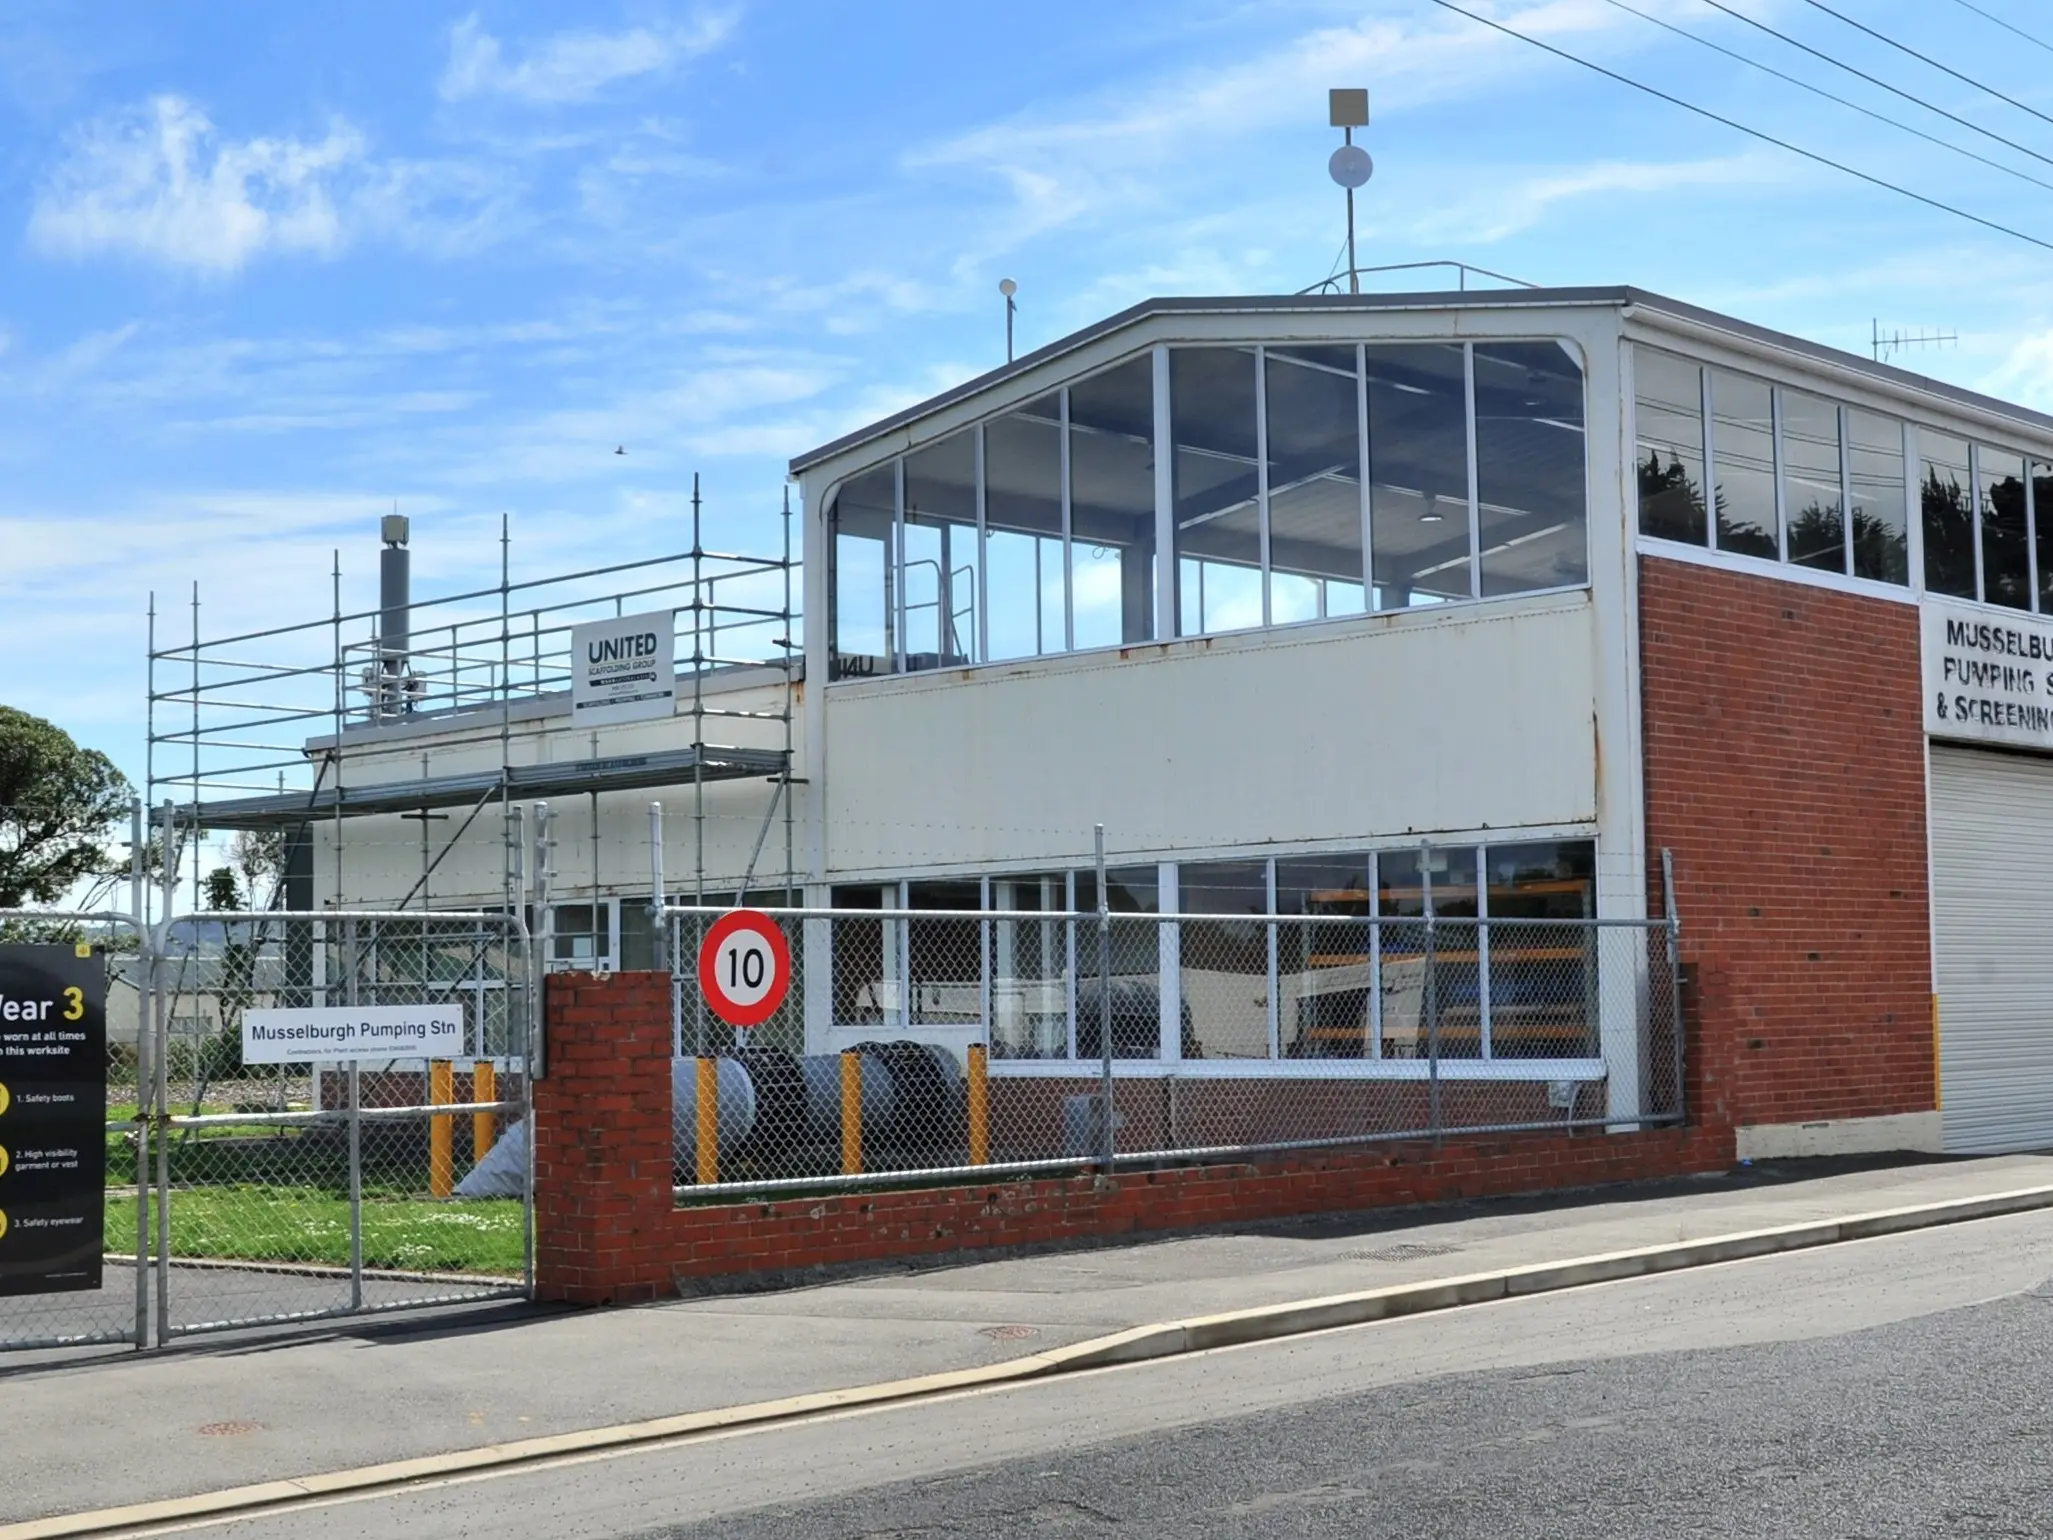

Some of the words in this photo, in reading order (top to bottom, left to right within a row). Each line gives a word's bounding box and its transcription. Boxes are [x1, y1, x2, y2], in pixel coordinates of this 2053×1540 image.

[589, 633, 657, 663] UNITED
[632, 659, 656, 670] GROUP
[1944, 656, 2034, 695] PUMPING
[1937, 692, 1948, 719] &
[728, 948, 764, 988] 10
[0, 994, 54, 1021] ear
[63, 986, 84, 1021] 3
[3, 1033, 29, 1041] worn
[31, 1032, 41, 1041] at
[43, 1031, 57, 1041] all
[58, 1031, 86, 1041] times
[251, 1023, 355, 1042] Musselburgh
[360, 1020, 426, 1040] Pumping
[430, 1019, 456, 1035] Stn
[5, 1046, 25, 1056] this
[26, 1045, 71, 1055] worksite
[16, 1094, 24, 1102] 1.
[25, 1094, 51, 1104] Safety
[52, 1094, 75, 1102] boots
[16, 1150, 23, 1159] 2.
[24, 1150, 43, 1160] High
[45, 1149, 77, 1158] visibility
[14, 1161, 50, 1172] garment
[61, 1160, 78, 1168] vest
[23, 1218, 48, 1228] Safety
[50, 1217, 84, 1227] eyewear
